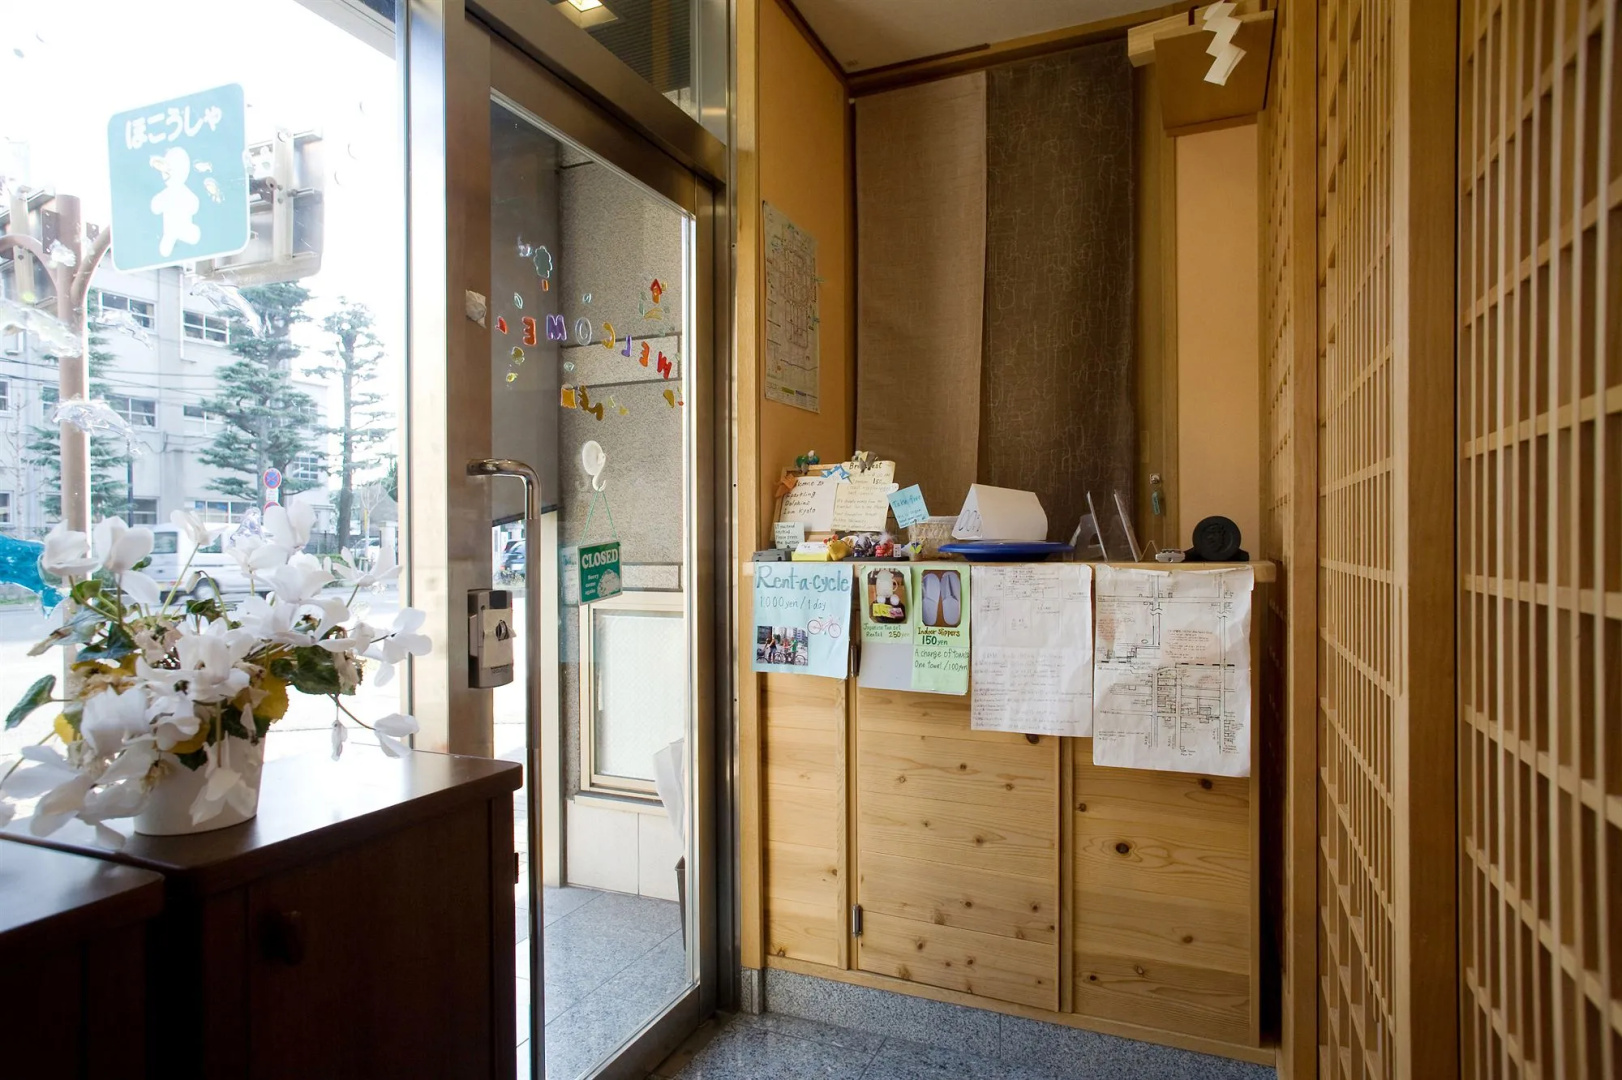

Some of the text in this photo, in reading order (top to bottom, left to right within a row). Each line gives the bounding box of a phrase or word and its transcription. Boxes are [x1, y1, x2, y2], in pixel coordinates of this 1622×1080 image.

[124, 105, 223, 150] ほこうしゃ
[581, 548, 619, 569] CLOSED
[917, 627, 937, 635] Indoor
[914, 648, 920, 657] A
